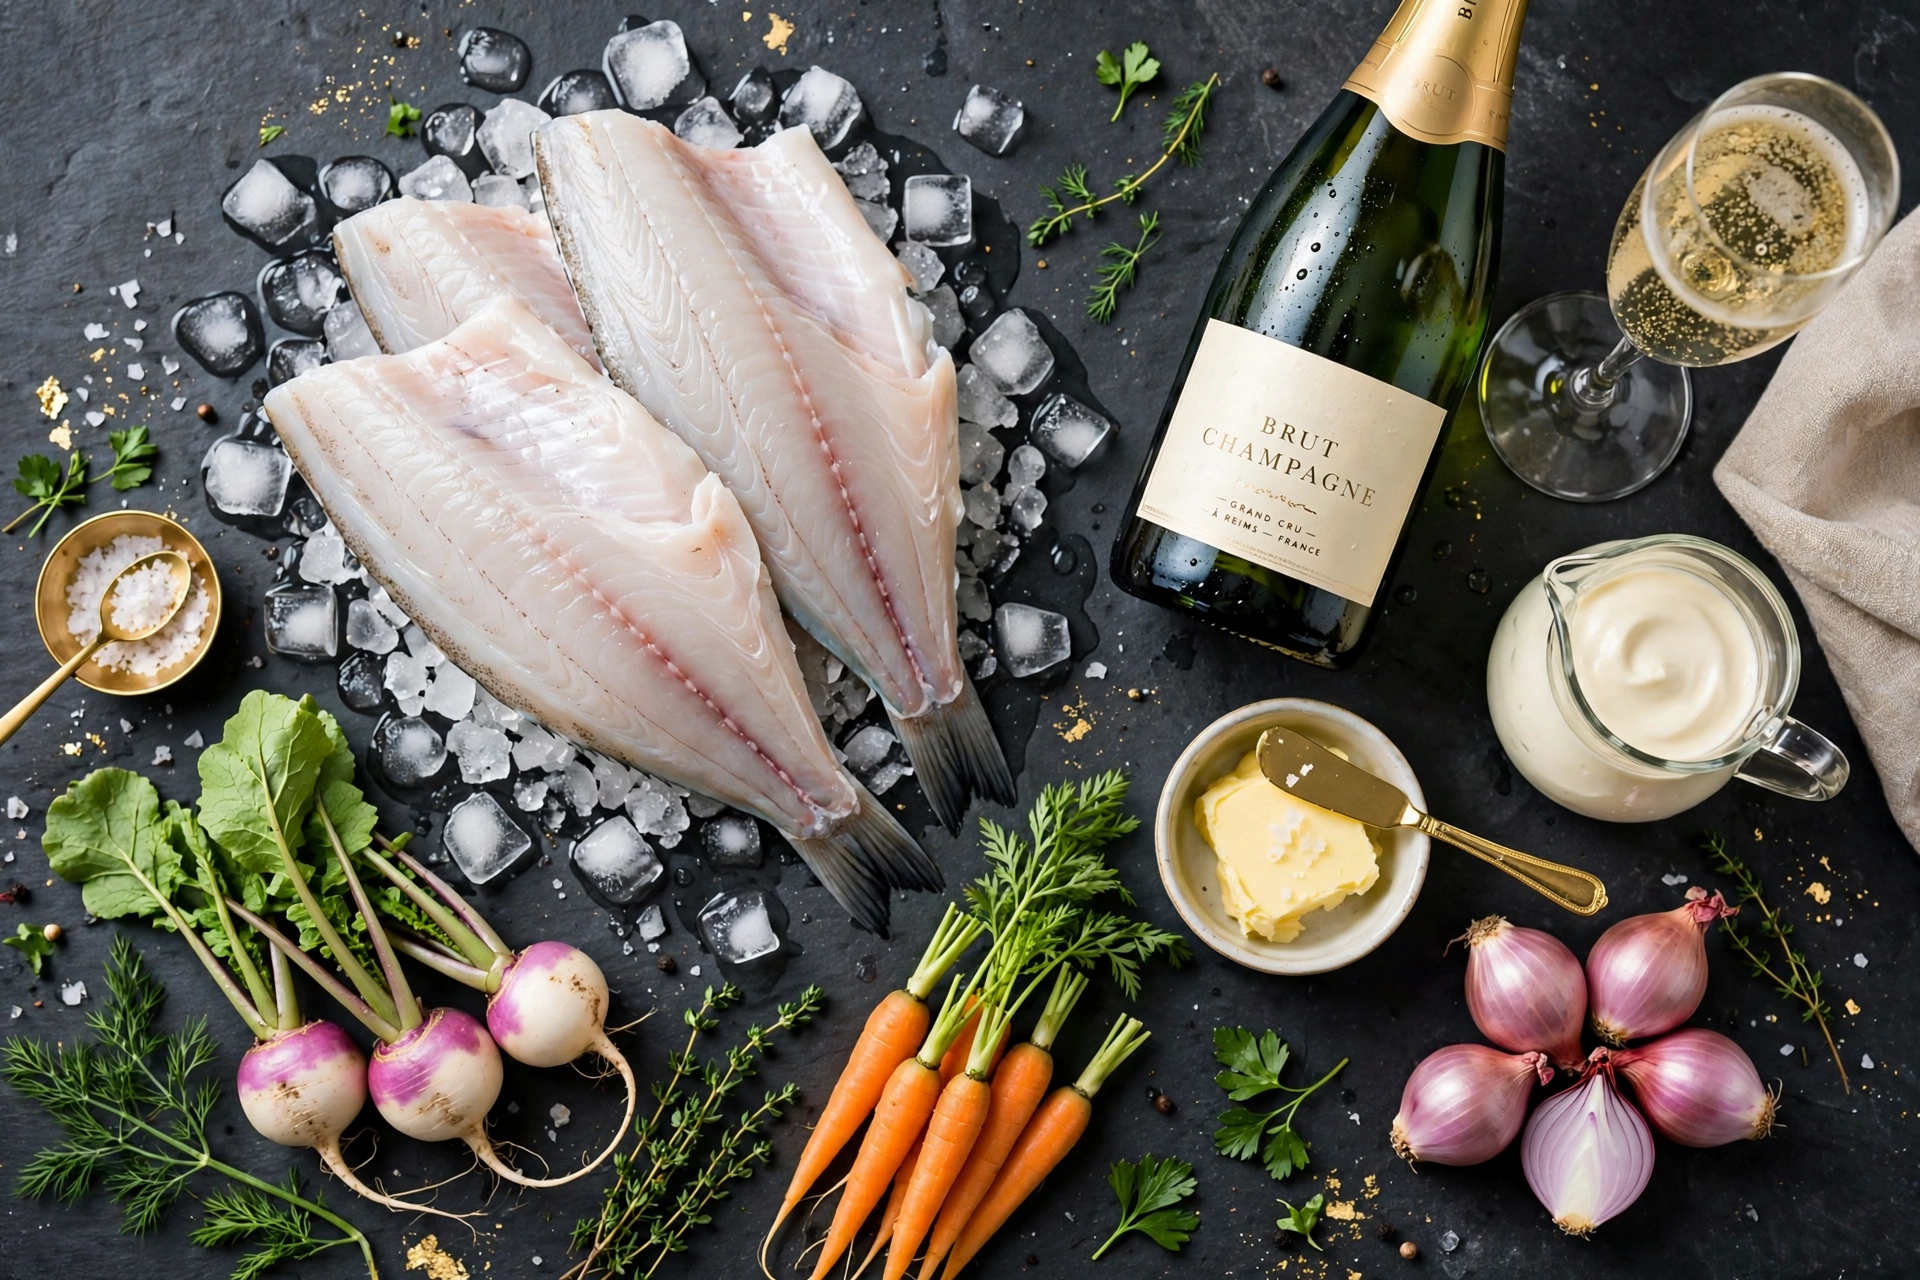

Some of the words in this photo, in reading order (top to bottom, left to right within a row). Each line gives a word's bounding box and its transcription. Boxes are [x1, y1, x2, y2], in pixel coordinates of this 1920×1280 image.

[1260, 416, 1339, 458] BRUT
[1202, 427, 1376, 508] CHAMPAGNE
[1224, 514, 1258, 533] REIMS
[1278, 535, 1321, 557] FRANCE
[1230, 500, 1272, 523] GRAND
[1278, 519, 1303, 534] CRU
